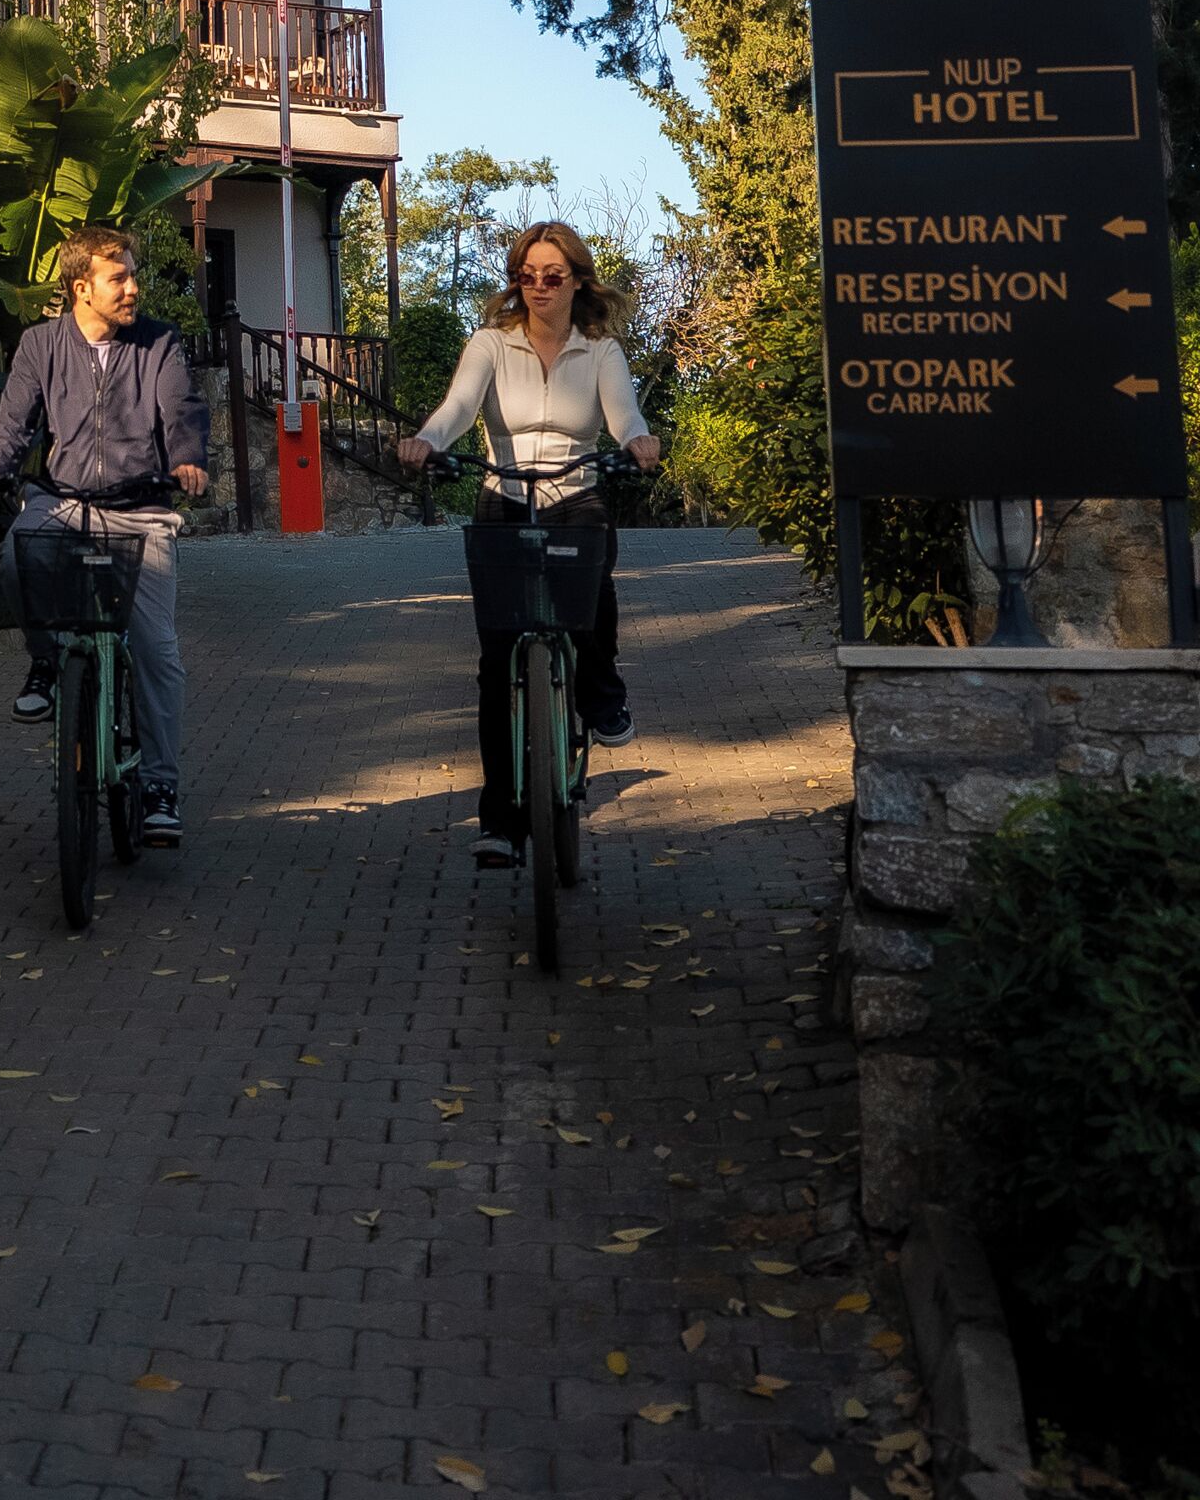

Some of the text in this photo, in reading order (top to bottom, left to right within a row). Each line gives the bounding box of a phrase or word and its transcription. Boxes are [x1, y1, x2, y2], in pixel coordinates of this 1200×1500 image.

[943, 58, 1023, 86] NUUP
[912, 90, 1058, 124] HOTEL
[832, 215, 1068, 246] RESTAURANT
[836, 264, 1068, 303] RESEPSİYON
[862, 311, 1012, 334] RECEPTION
[840, 358, 1015, 388] OTOPARK
[866, 392, 992, 414] CARPARK
